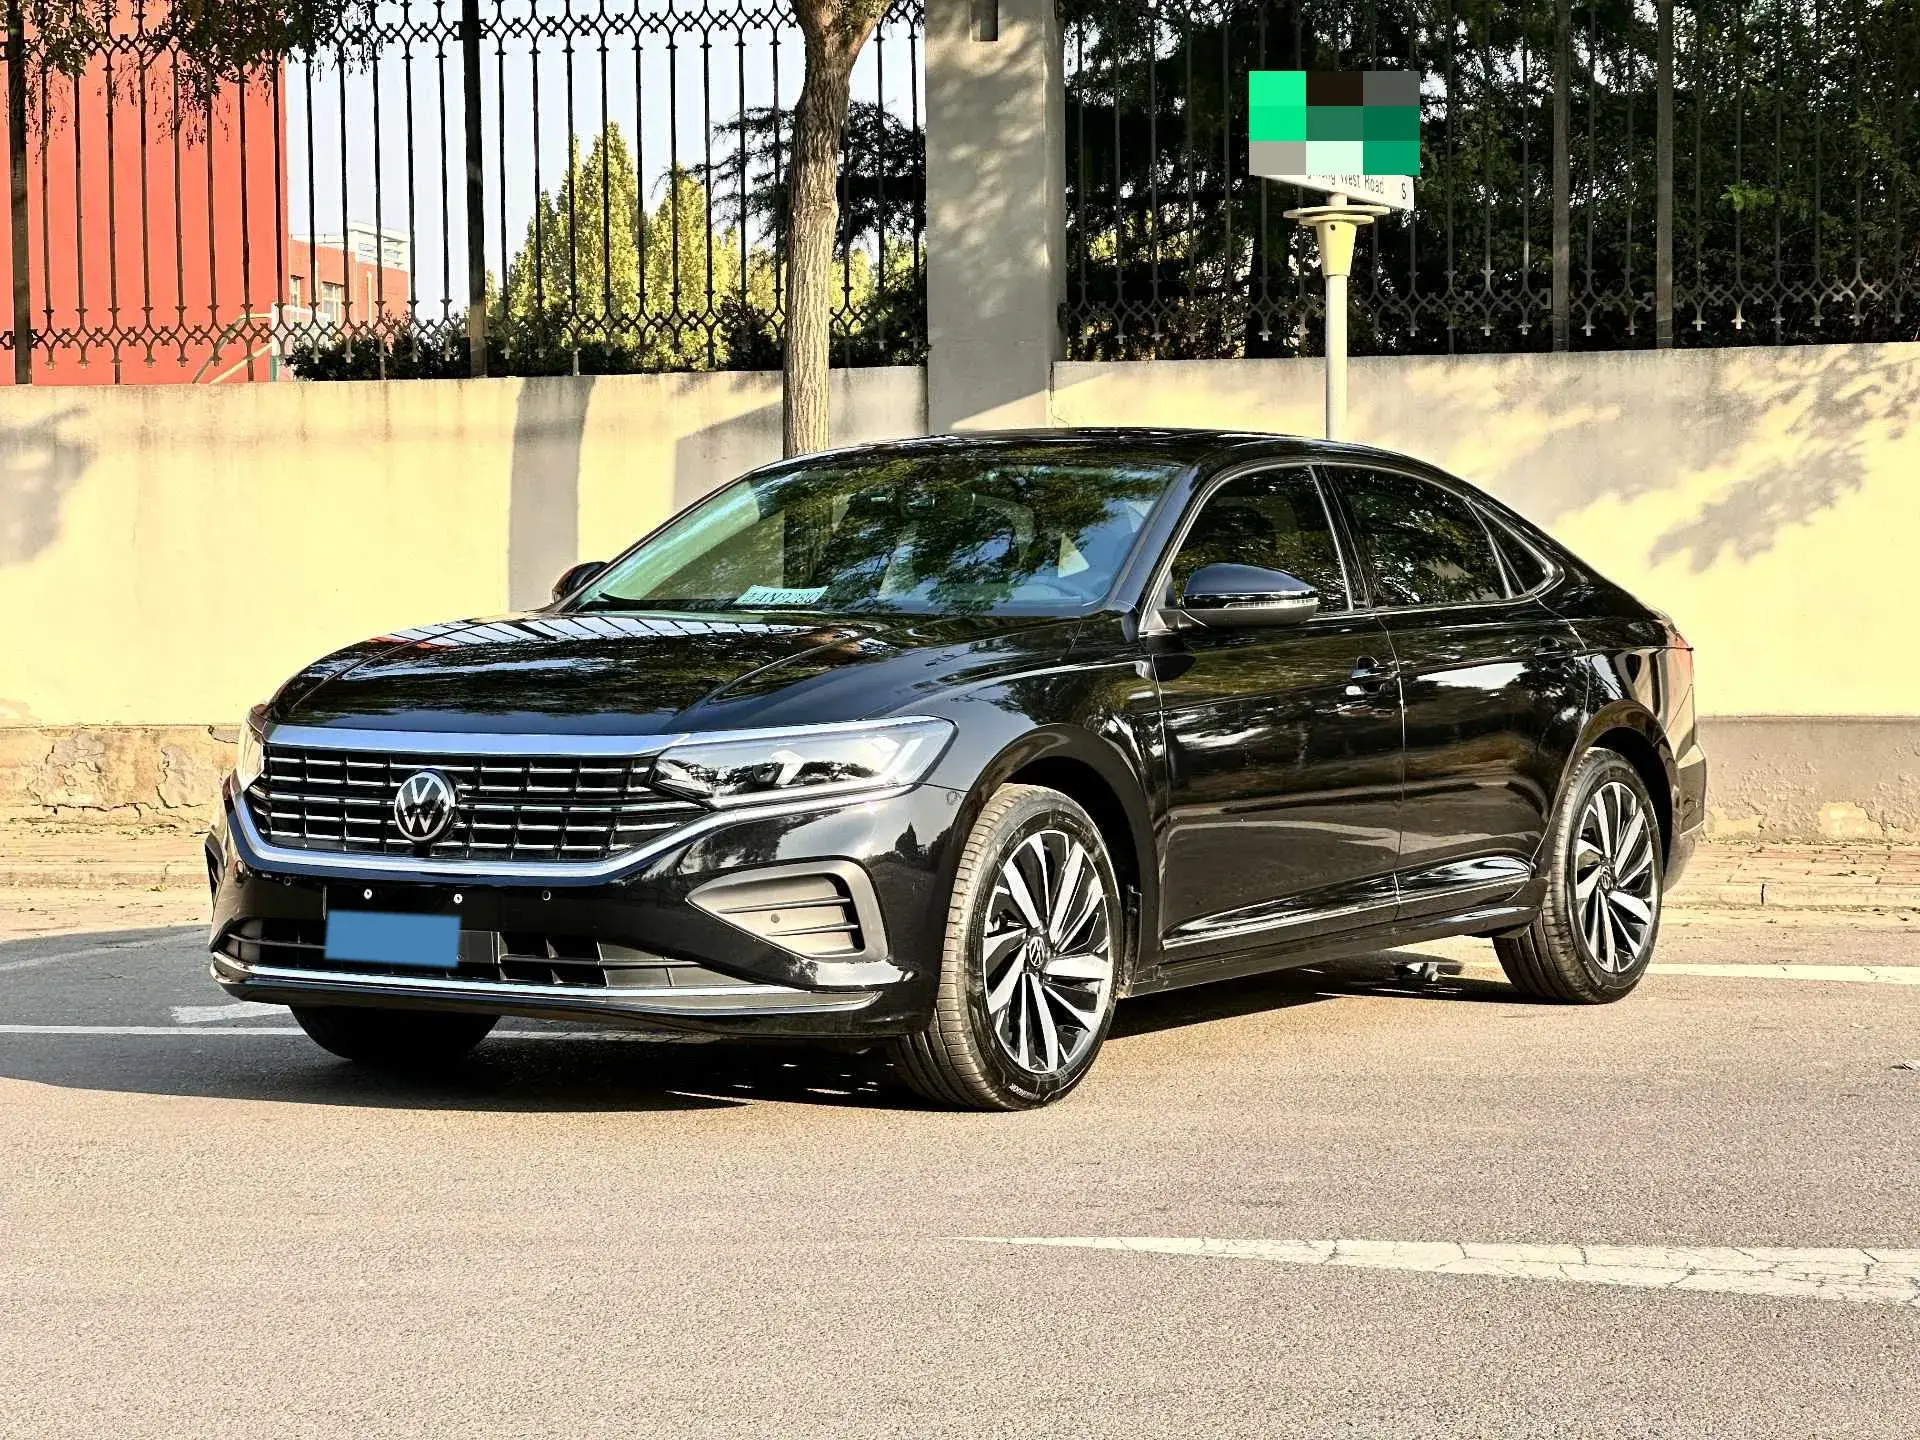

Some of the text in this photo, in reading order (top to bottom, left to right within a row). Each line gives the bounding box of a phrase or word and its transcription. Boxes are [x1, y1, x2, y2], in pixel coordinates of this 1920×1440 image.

[1364, 175, 1384, 194] Road
[1401, 182, 1407, 199] S
[394, 772, 451, 841] VW
